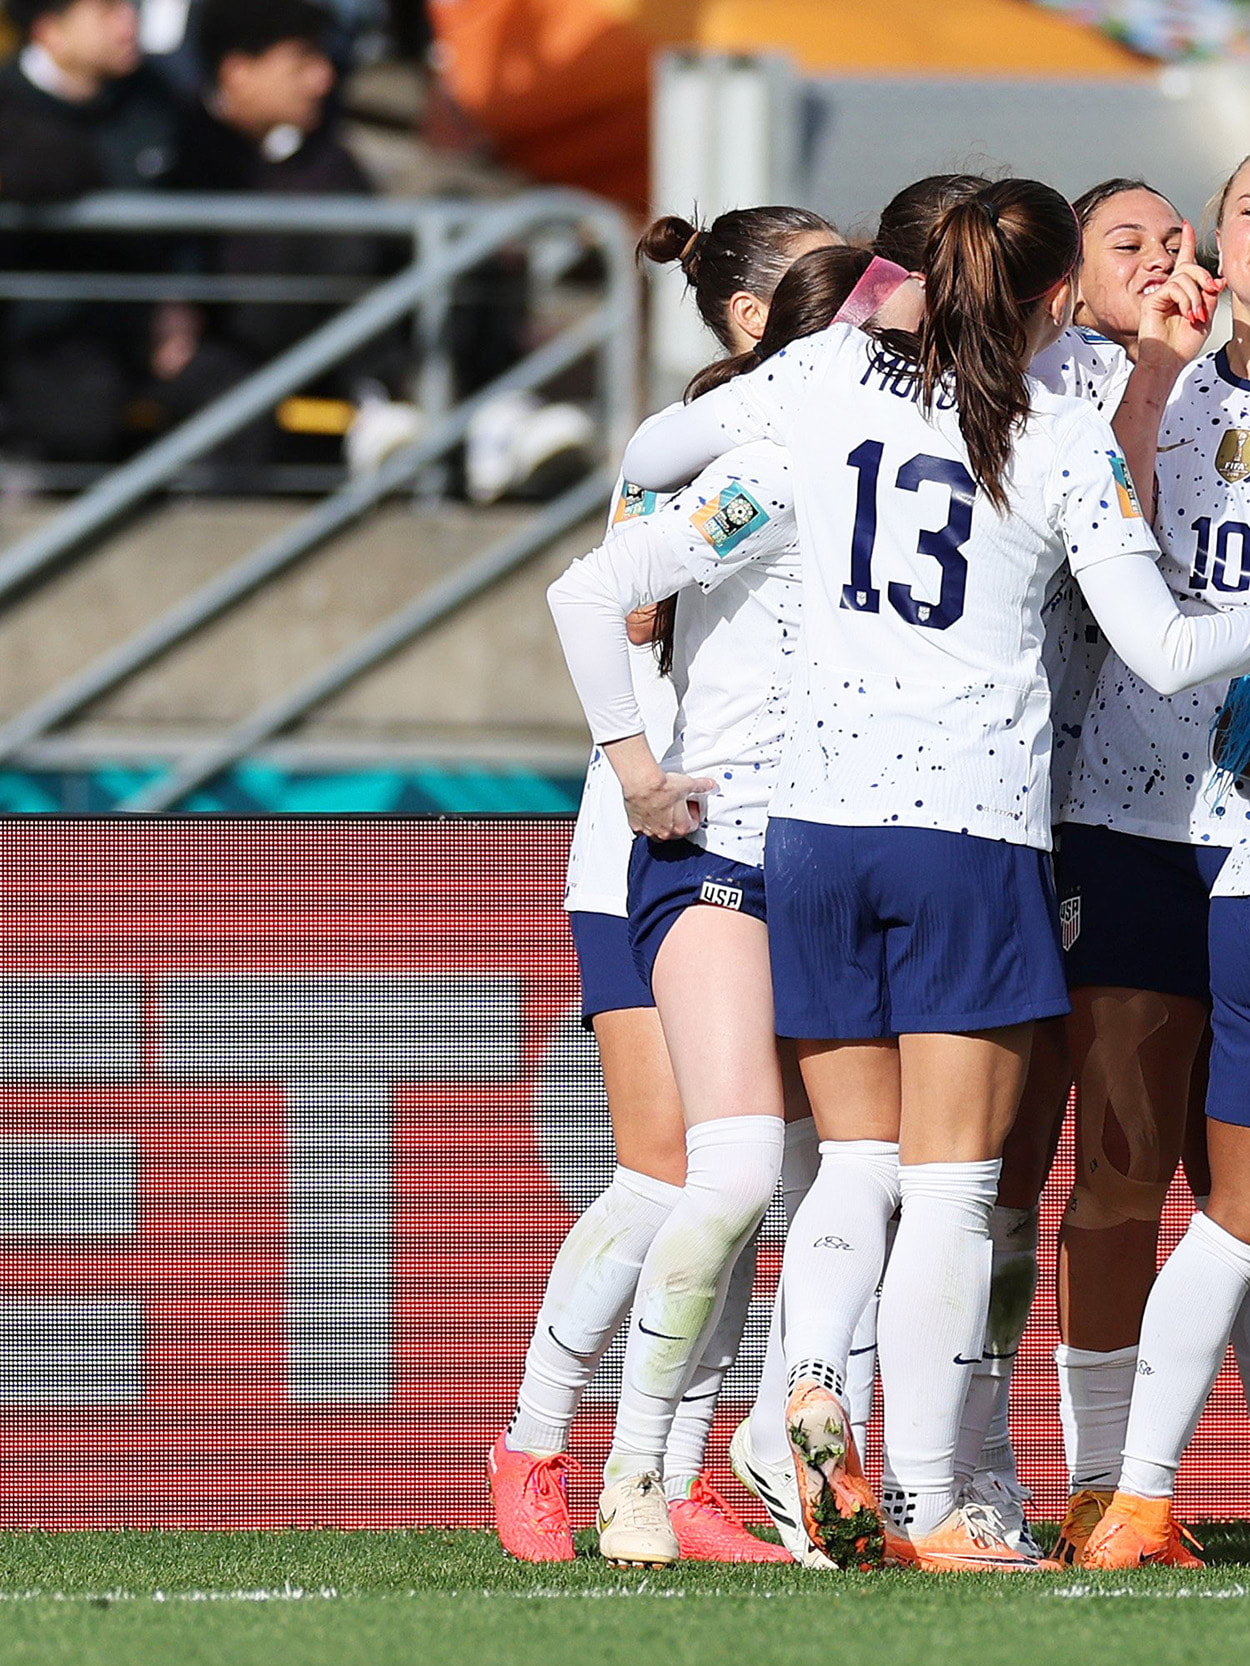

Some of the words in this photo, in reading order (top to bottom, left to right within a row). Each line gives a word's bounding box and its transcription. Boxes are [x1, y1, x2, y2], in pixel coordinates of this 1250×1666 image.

[1224, 462, 1245, 470] FIFA
[840, 439, 977, 630] 13
[704, 886, 739, 906] USA
[1060, 900, 1079, 921] USA
